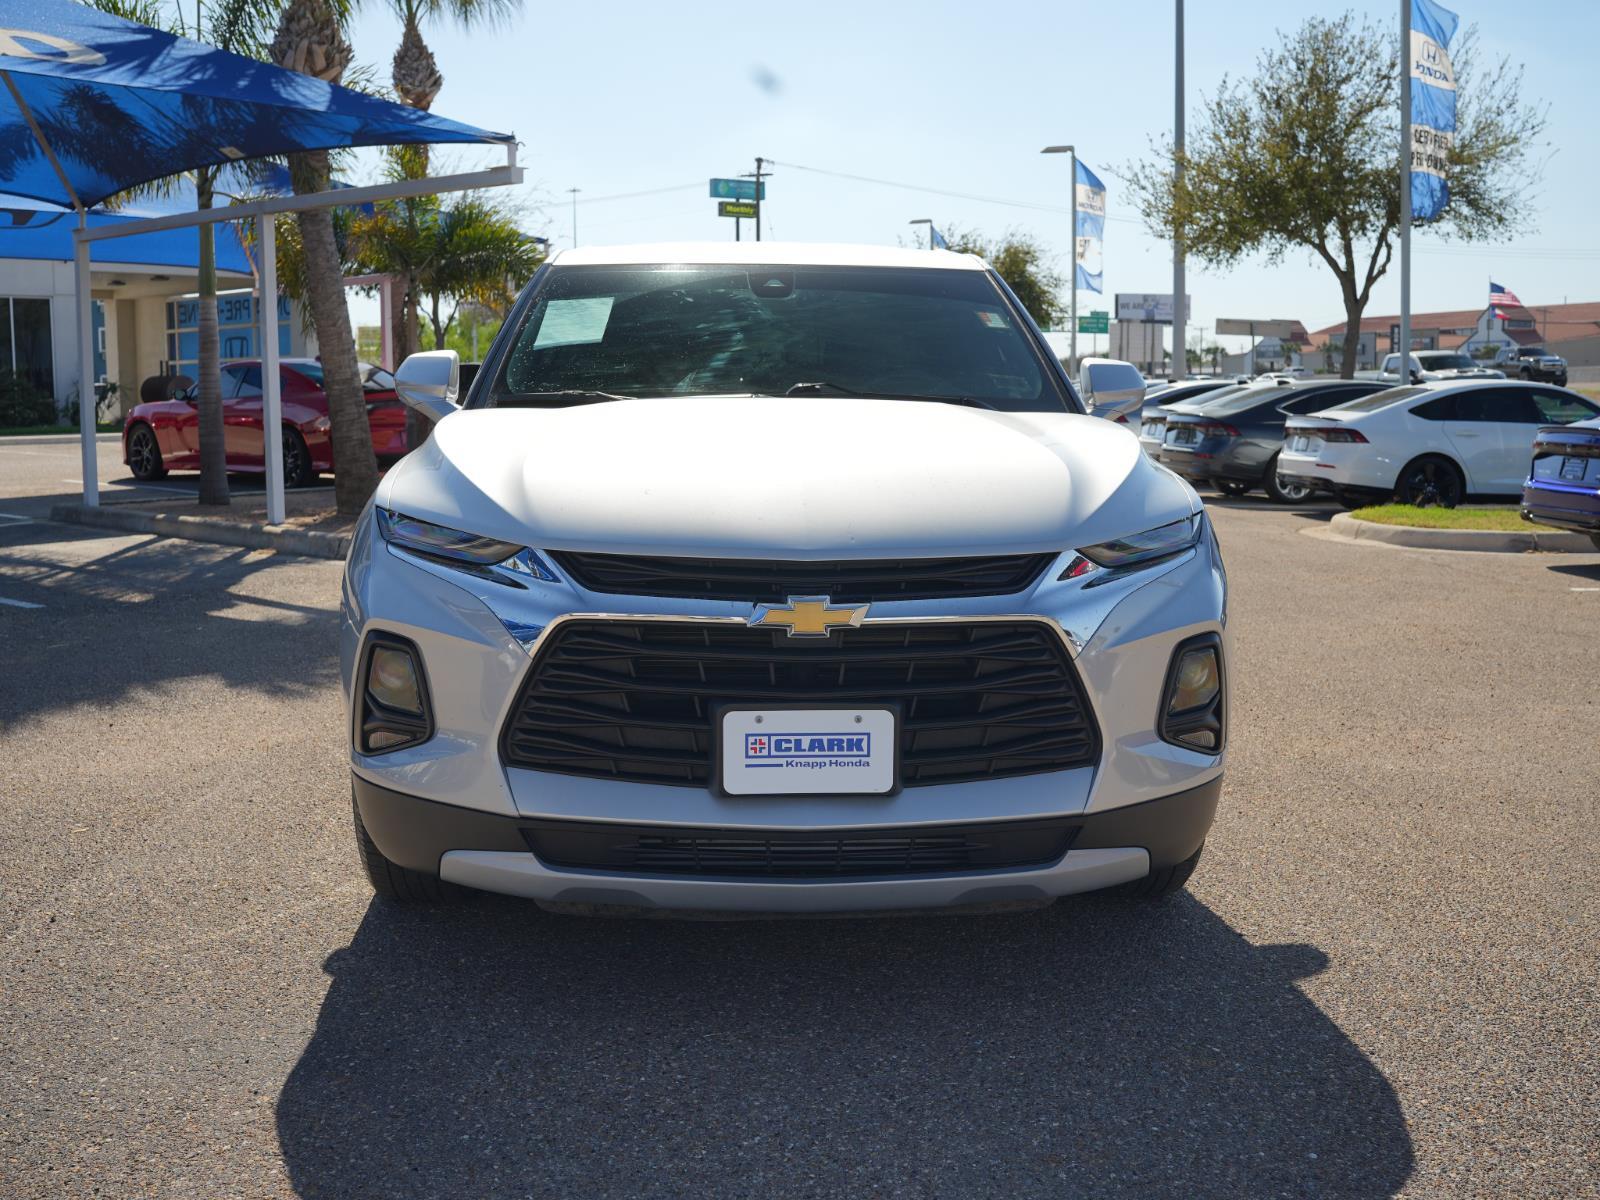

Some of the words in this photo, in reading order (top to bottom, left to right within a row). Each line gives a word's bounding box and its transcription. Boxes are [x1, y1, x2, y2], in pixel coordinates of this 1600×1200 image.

[774, 738, 864, 752] CLARK
[785, 759, 827, 769] Knapp
[828, 759, 870, 768] Honda
